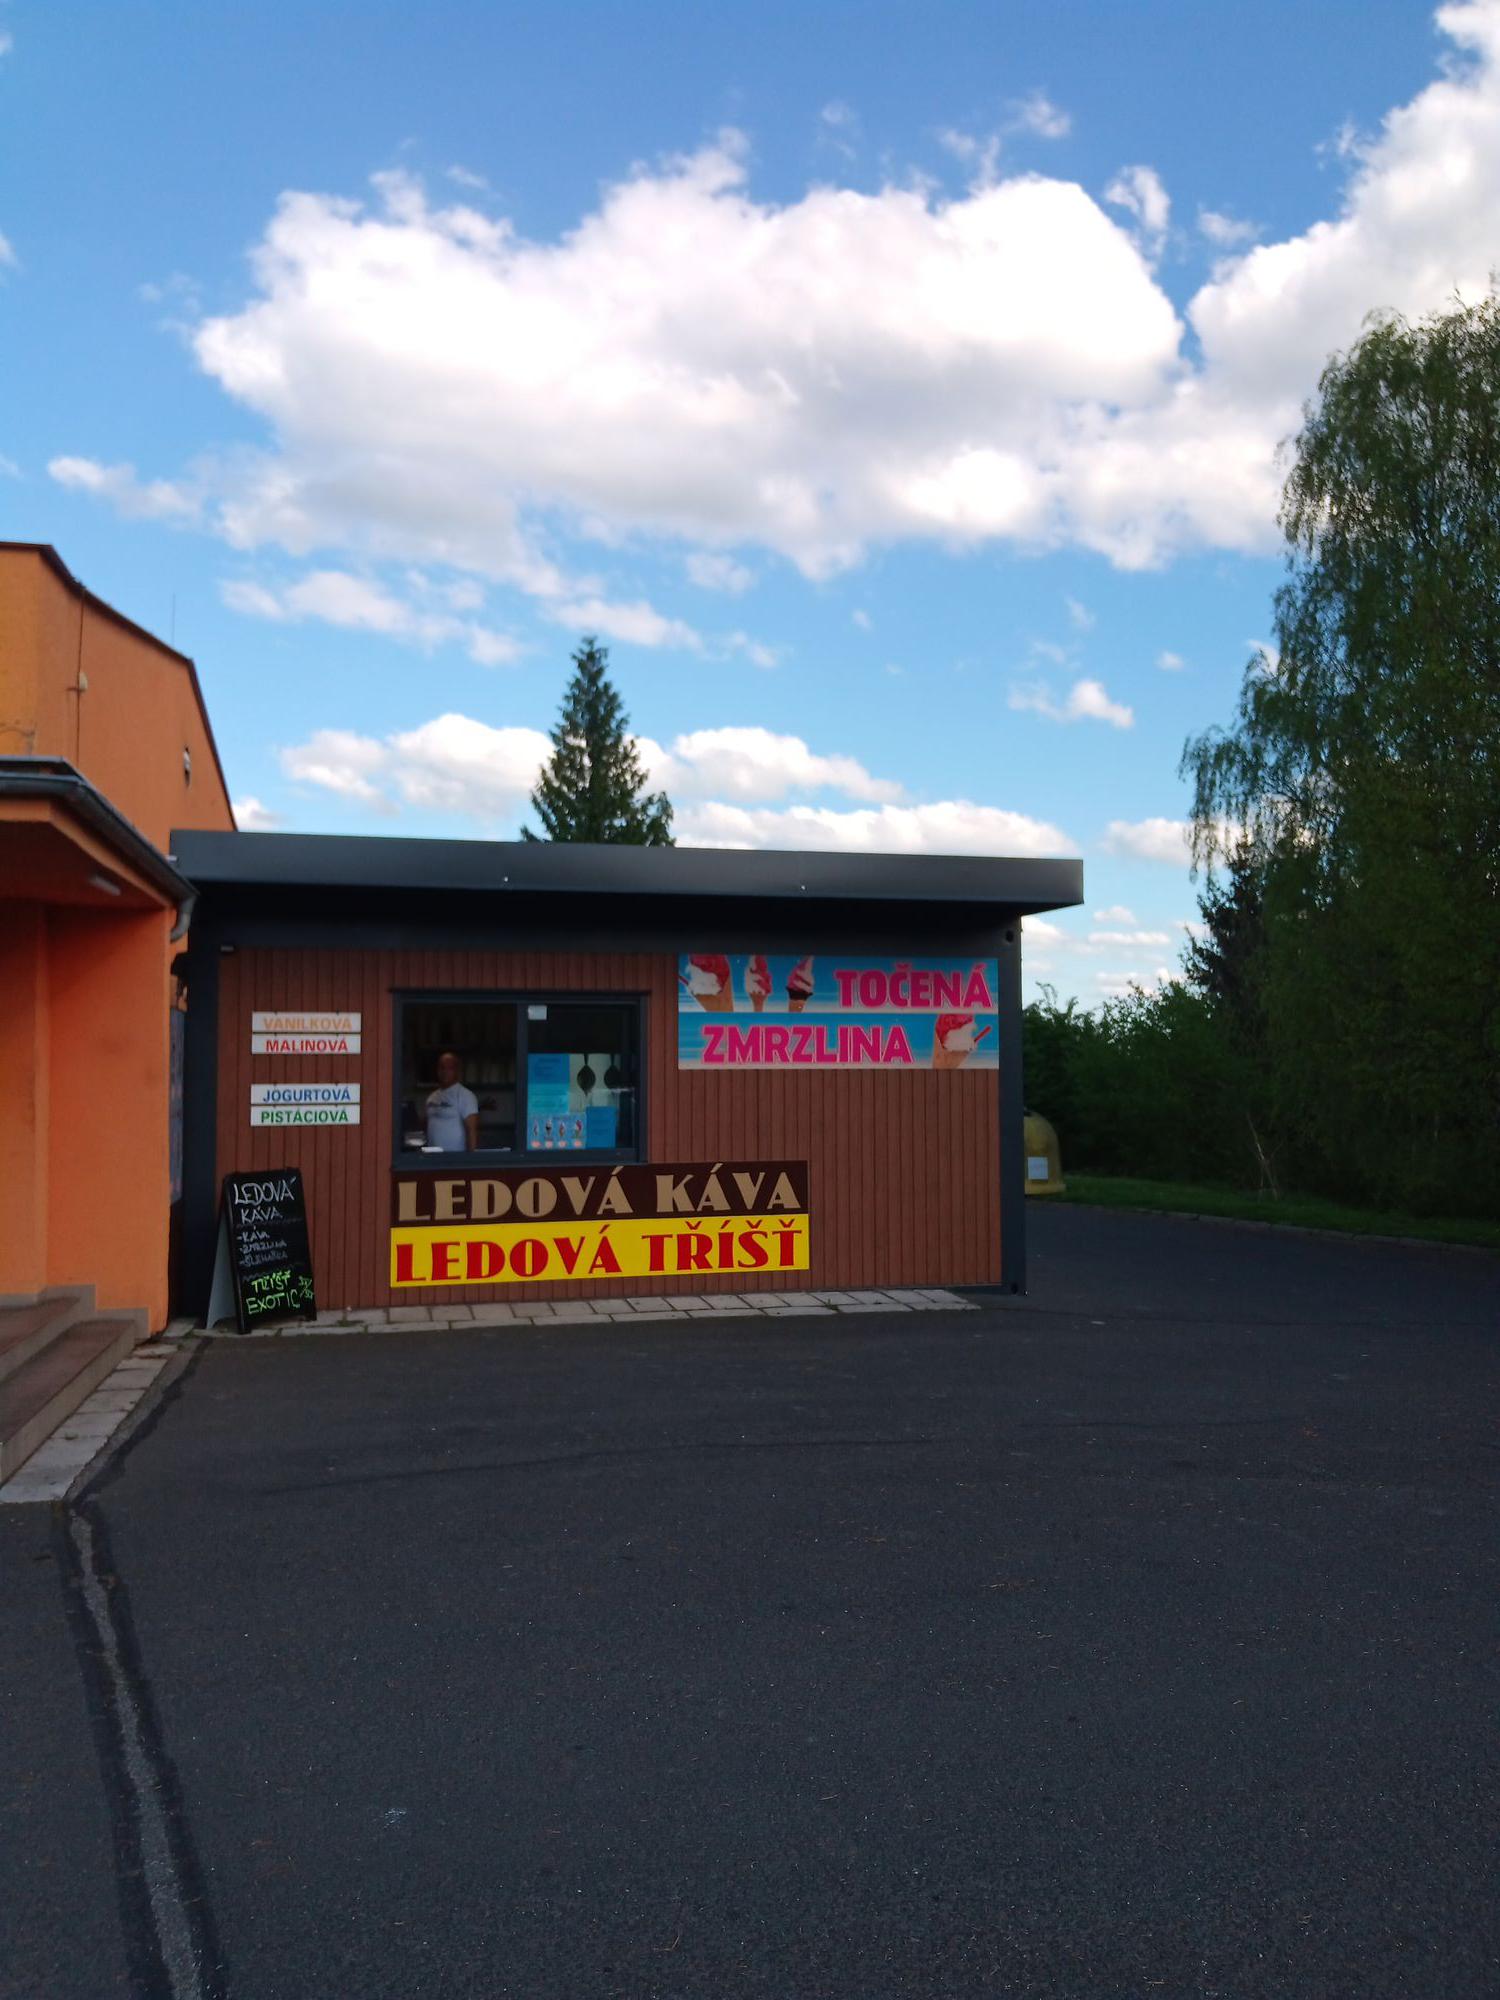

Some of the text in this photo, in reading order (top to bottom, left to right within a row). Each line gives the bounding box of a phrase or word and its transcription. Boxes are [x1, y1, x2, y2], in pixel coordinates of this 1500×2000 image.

[834, 962, 993, 1009] TOČENÁ
[266, 1037, 349, 1052] MALINOVÁ
[701, 1024, 915, 1064] ZMRZLINA
[263, 1087, 351, 1103] JOGURTOVÁ
[261, 1108, 349, 1124] PISTÁCIOVÁ
[234, 1176, 297, 1206] LEDOVÁ
[398, 1163, 801, 1221] LEDOVÁ KÁVA
[241, 1206, 284, 1225] KÁVA
[396, 1219, 802, 1282] LEDOVÁ TŘÍŠŤ
[246, 1289, 301, 1314] EXOTIC
